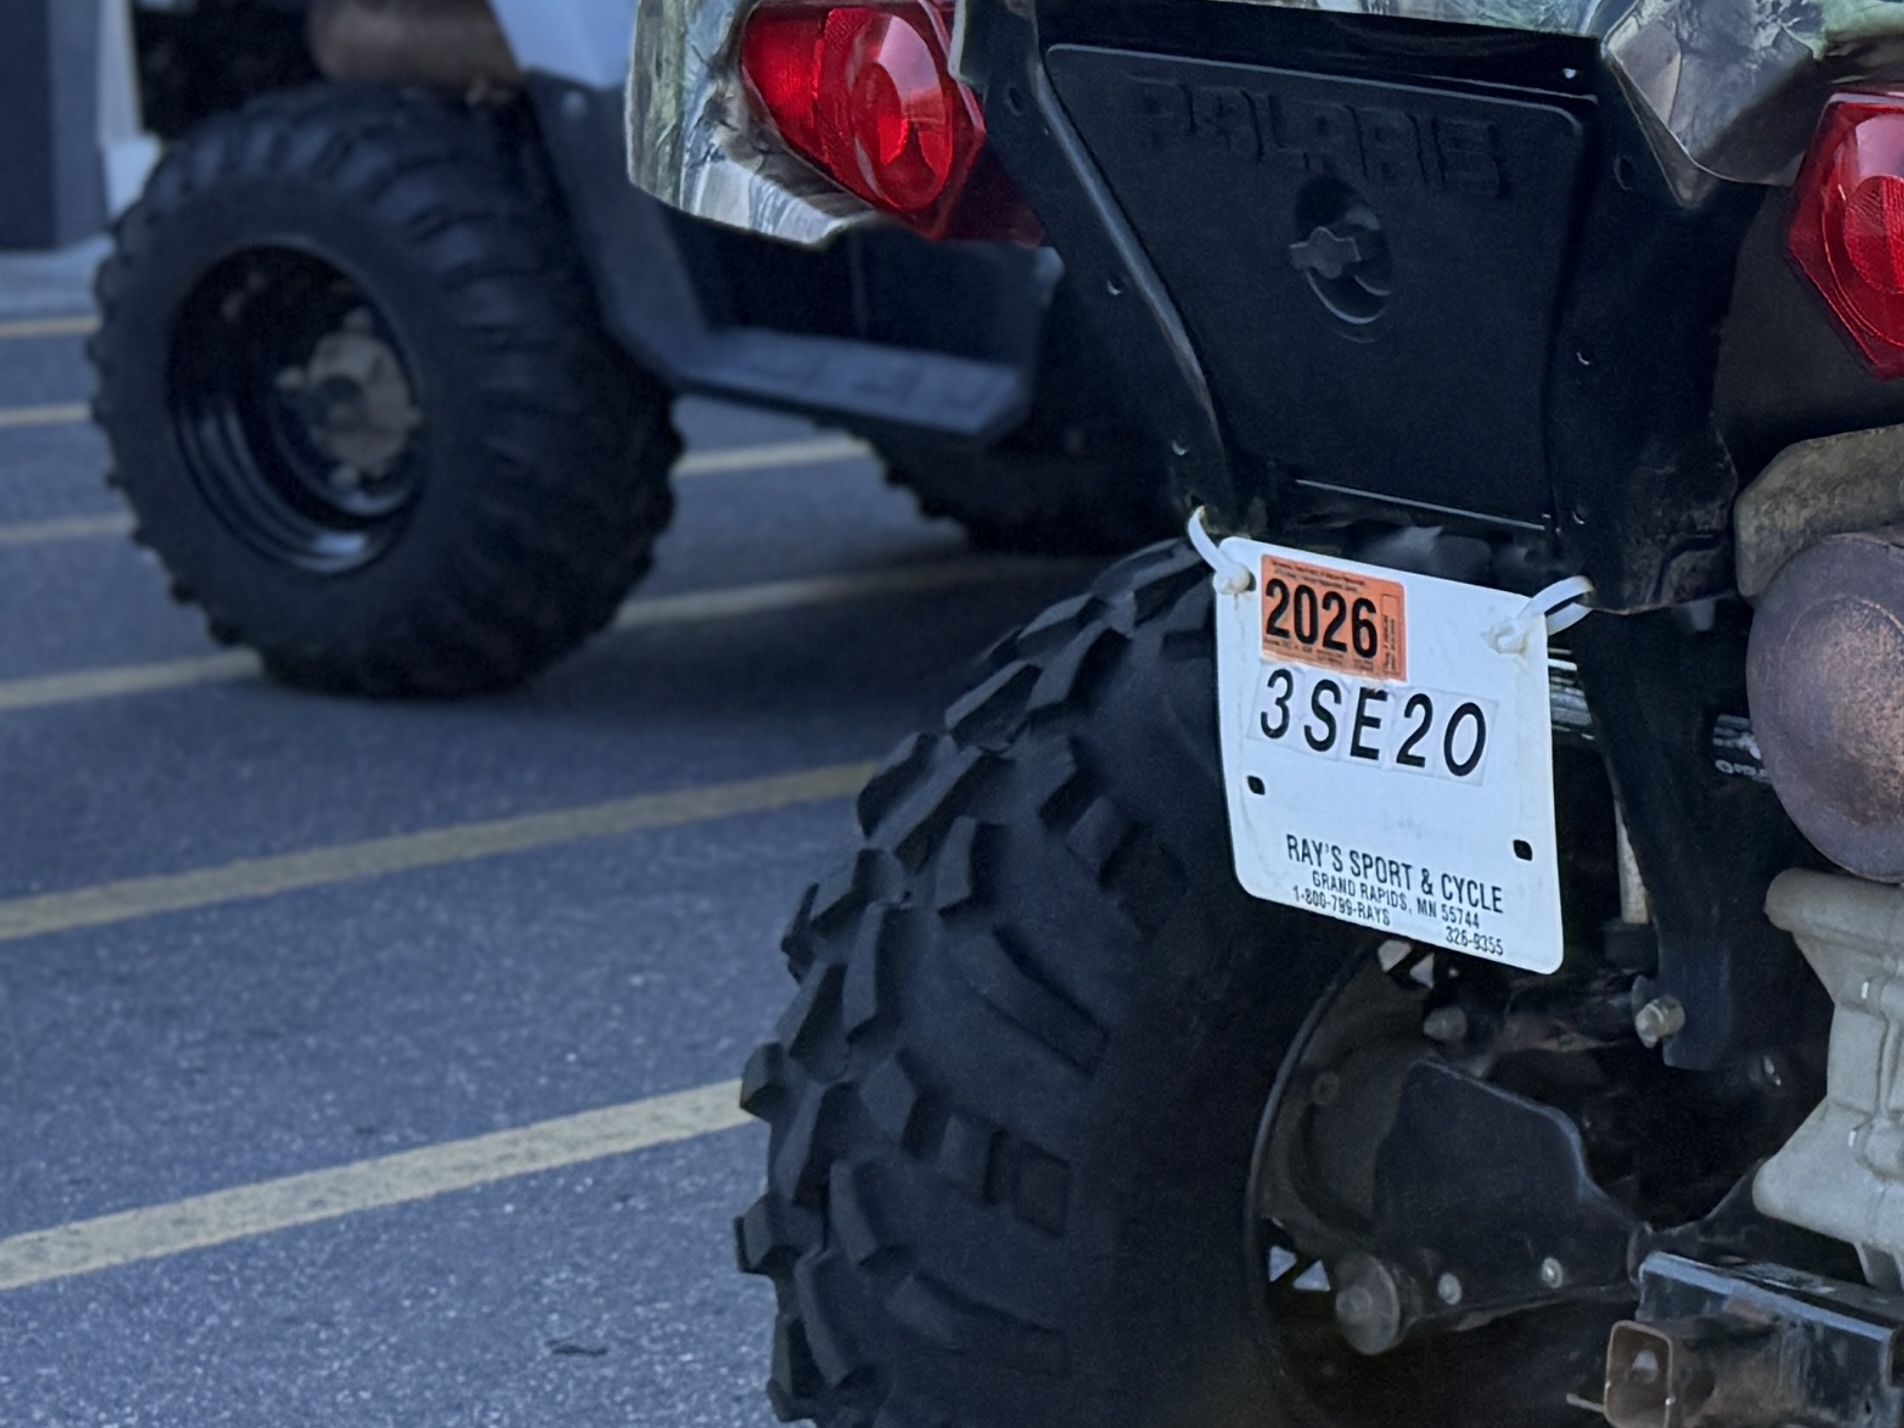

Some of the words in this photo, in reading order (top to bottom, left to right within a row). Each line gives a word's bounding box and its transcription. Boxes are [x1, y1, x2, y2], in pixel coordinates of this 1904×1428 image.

[1265, 578, 1378, 659] 2026
[1260, 668, 1487, 777] 3SE20
[1286, 833, 1344, 873] RAY'S
[1349, 850, 1413, 891] SPORT
[1421, 868, 1434, 896] &
[1442, 873, 1504, 914] CYCLE
[1293, 885, 1391, 926] 1-800-799-RAYS
[1312, 870, 1356, 897] GRAND
[1360, 882, 1412, 914] RAPIDS,
[1417, 897, 1437, 918] MN
[1441, 903, 1480, 930] 55744
